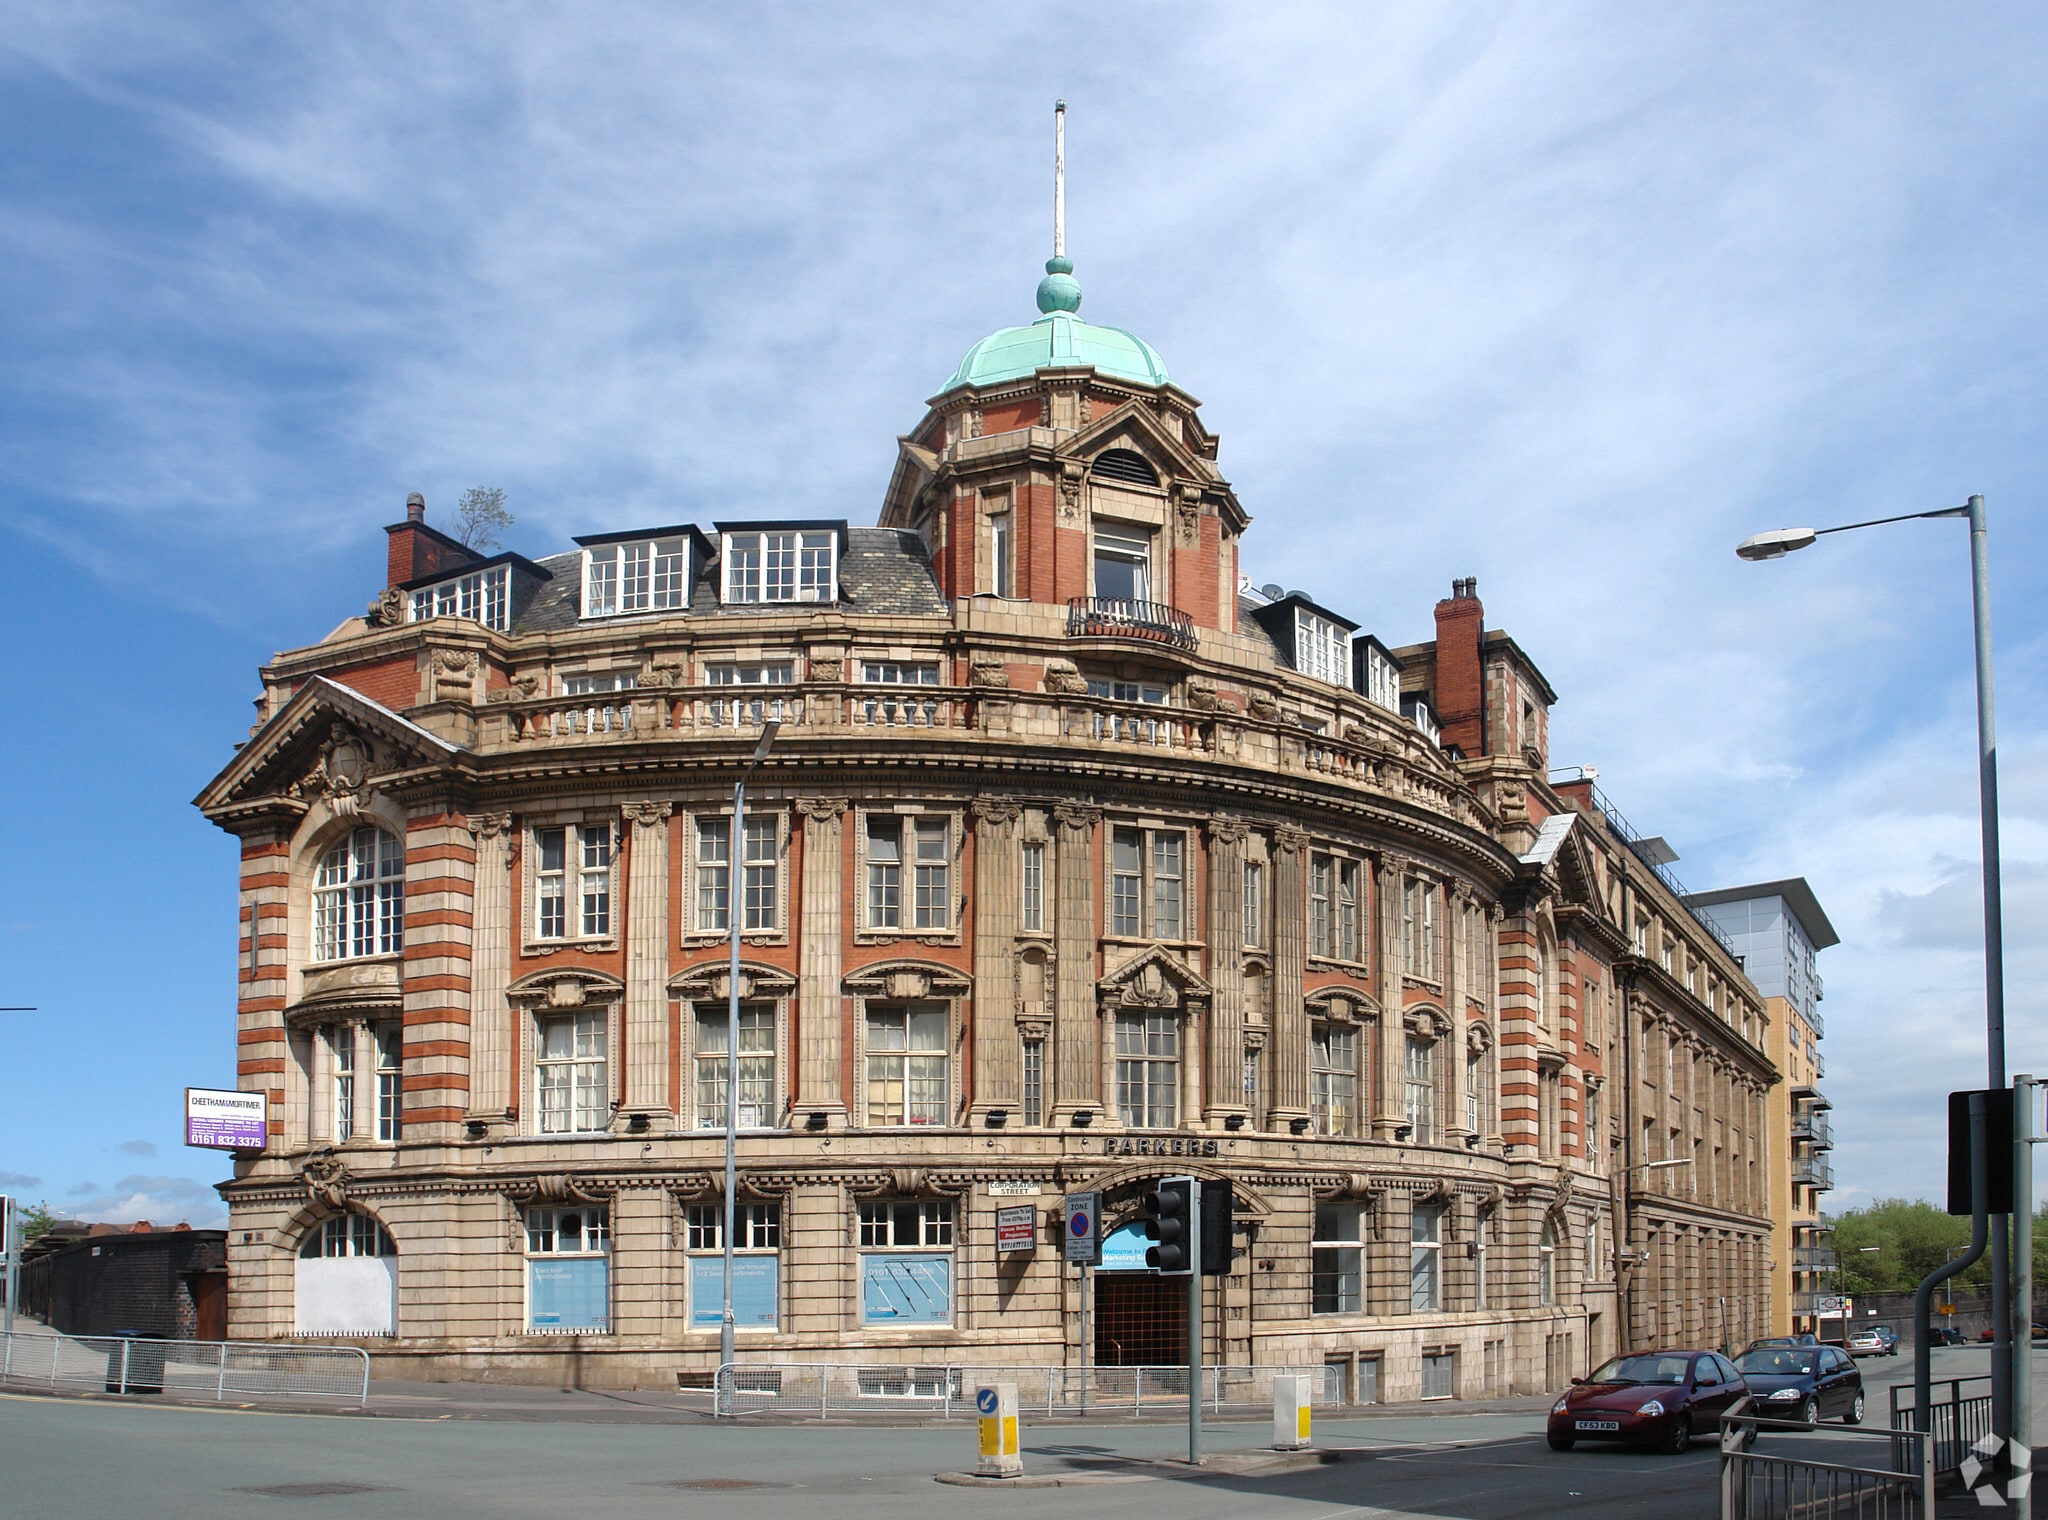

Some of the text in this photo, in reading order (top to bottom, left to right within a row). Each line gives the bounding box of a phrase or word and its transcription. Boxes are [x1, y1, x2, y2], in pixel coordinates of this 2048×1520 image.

[191, 1135, 262, 1147] 0161 832 3375
[1104, 1138, 1217, 1156] PARKERS
[1071, 1203, 1088, 1211] ZONE
